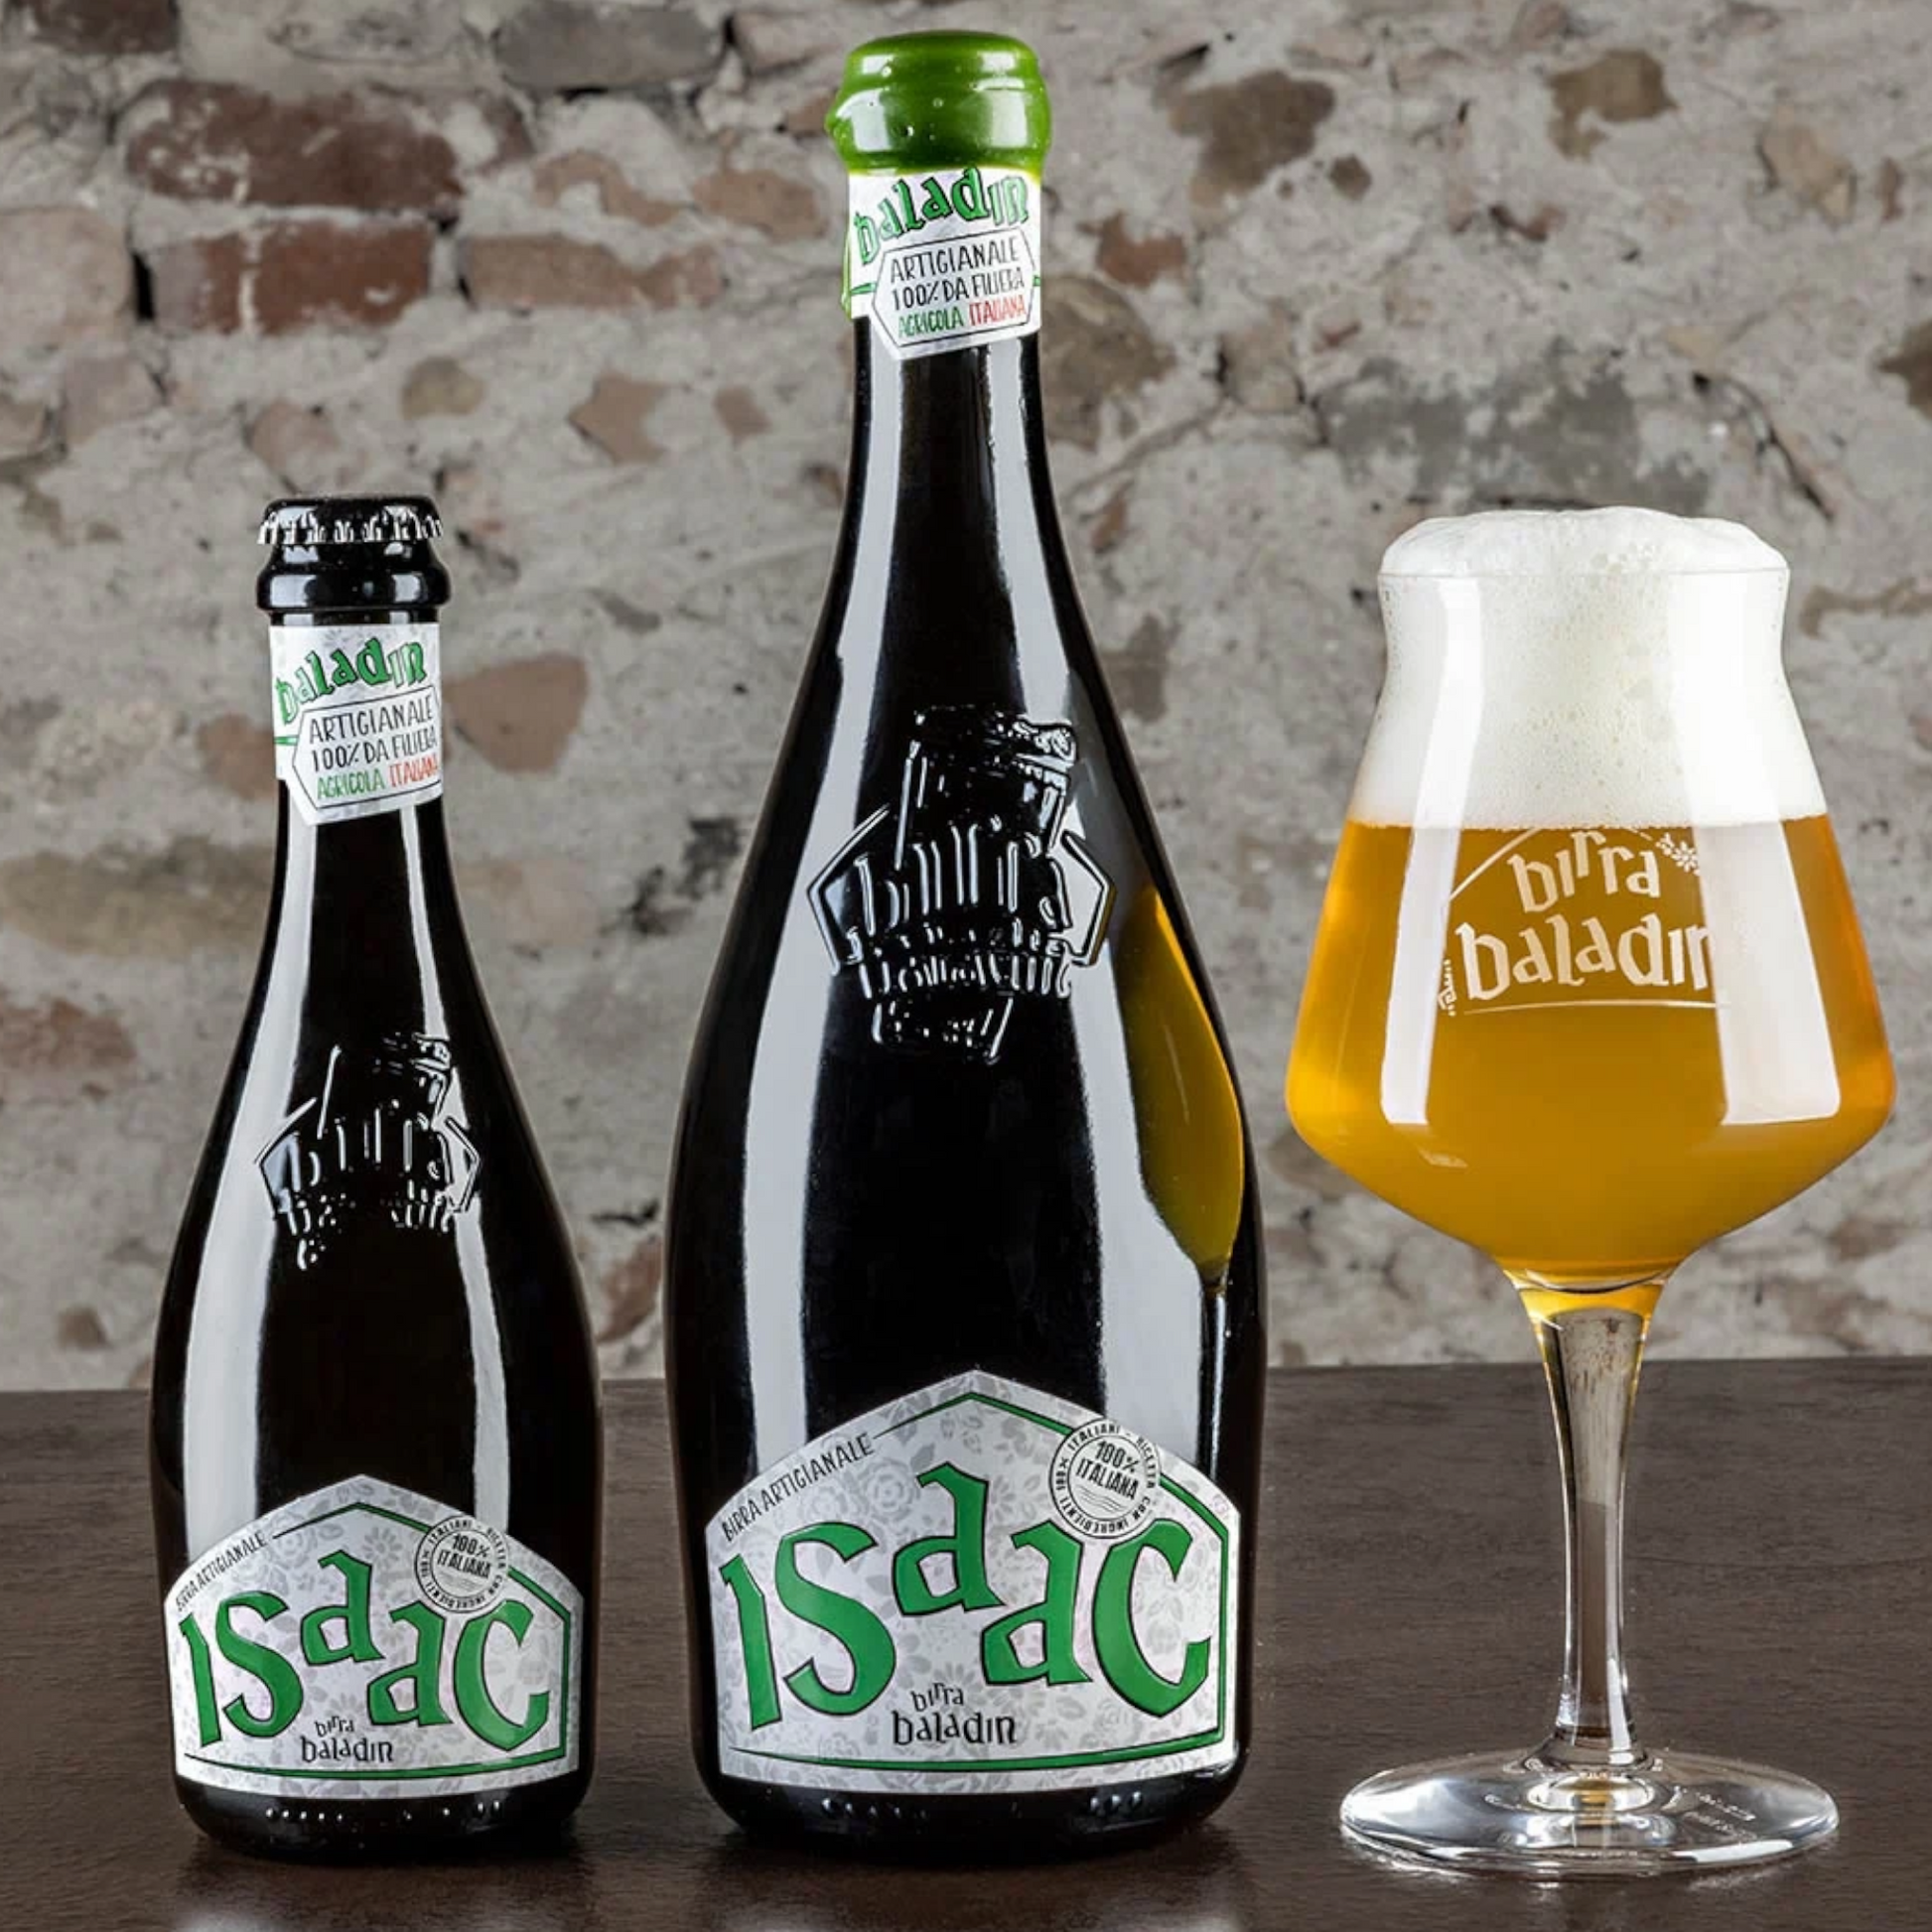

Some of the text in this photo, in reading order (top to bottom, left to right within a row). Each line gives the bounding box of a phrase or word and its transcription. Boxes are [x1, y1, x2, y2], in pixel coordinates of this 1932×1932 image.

[854, 167, 1030, 266] baladin
[891, 236, 1020, 284] ARTIGIANALE
[893, 279, 939, 311] 100%
[942, 276, 970, 302] DA
[897, 305, 965, 339] AGRICOLA
[275, 636, 428, 726] baladin
[309, 693, 434, 745] ARTIGIANALE
[311, 742, 360, 772] 100%
[363, 738, 390, 763] DA
[317, 767, 385, 800] AGRICOLA
[1507, 830, 1662, 913] birra
[1095, 1441, 1140, 1473] 100%
[721, 1432, 875, 1542] BIRRA ARTIGIANALE
[1075, 1457, 1140, 1500] ITALIANA
[452, 1533, 490, 1558] 100%
[910, 1682, 965, 1713] birra
[314, 1716, 355, 1737] birra
[891, 1709, 1018, 1745] baladin
[300, 1734, 394, 1763] baladin
